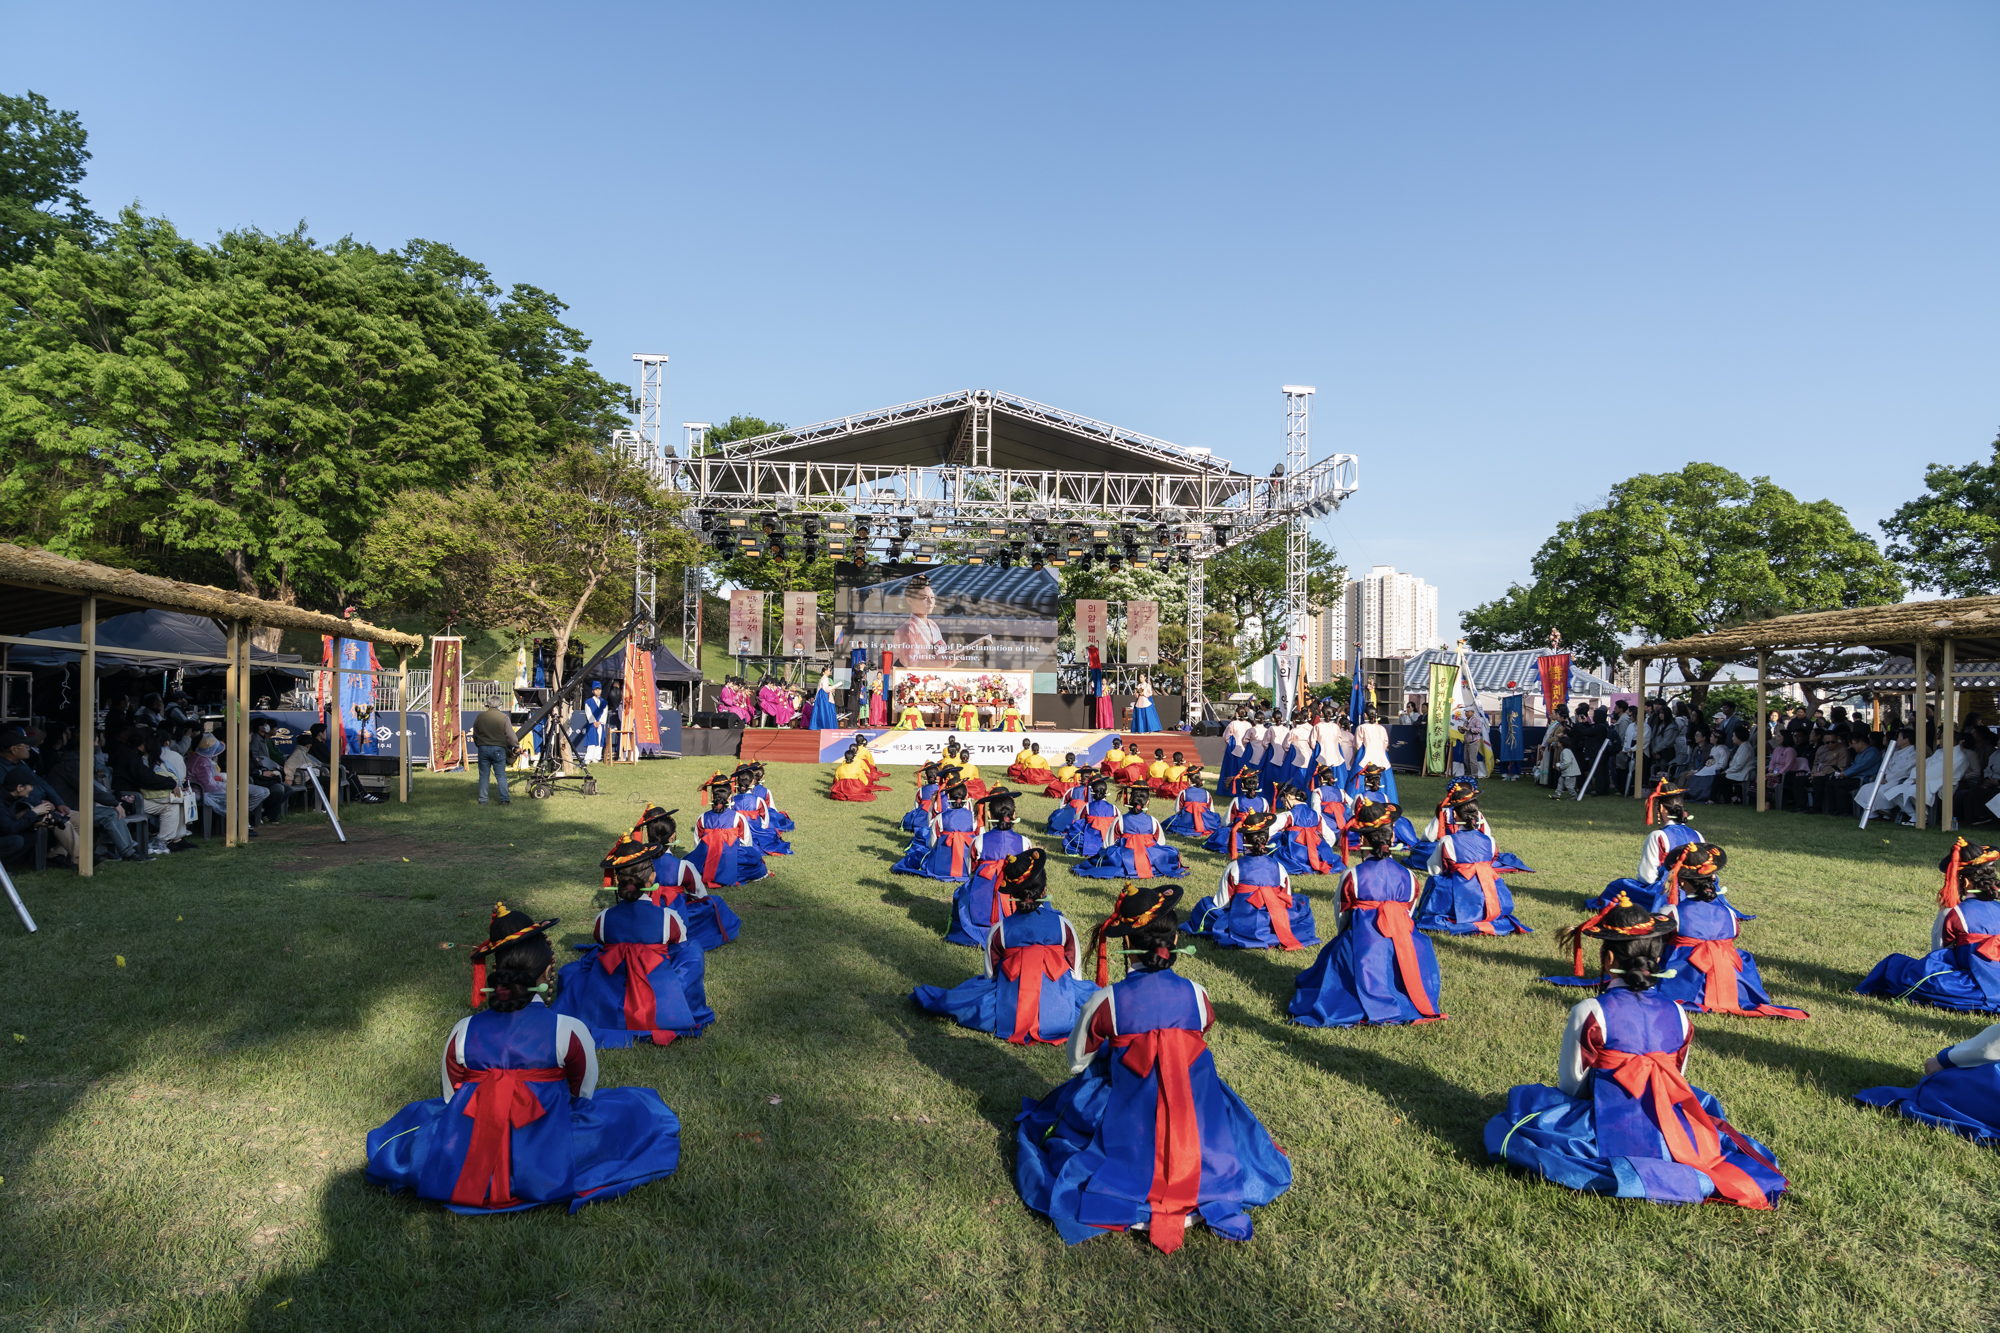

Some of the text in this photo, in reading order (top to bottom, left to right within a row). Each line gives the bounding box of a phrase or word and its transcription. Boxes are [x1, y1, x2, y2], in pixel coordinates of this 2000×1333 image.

[795, 596, 805, 636] 의암별제
[1087, 604, 1096, 643] 의암별제
[871, 641, 878, 649] is
[946, 643, 954, 651] of
[956, 643, 1013, 653] Proclamation
[1015, 644, 1024, 653] of
[1026, 645, 1040, 653] the
[941, 653, 980, 662] welcome.
[892, 743, 922, 751] 제24회
[925, 742, 1014, 755] 진논개제
